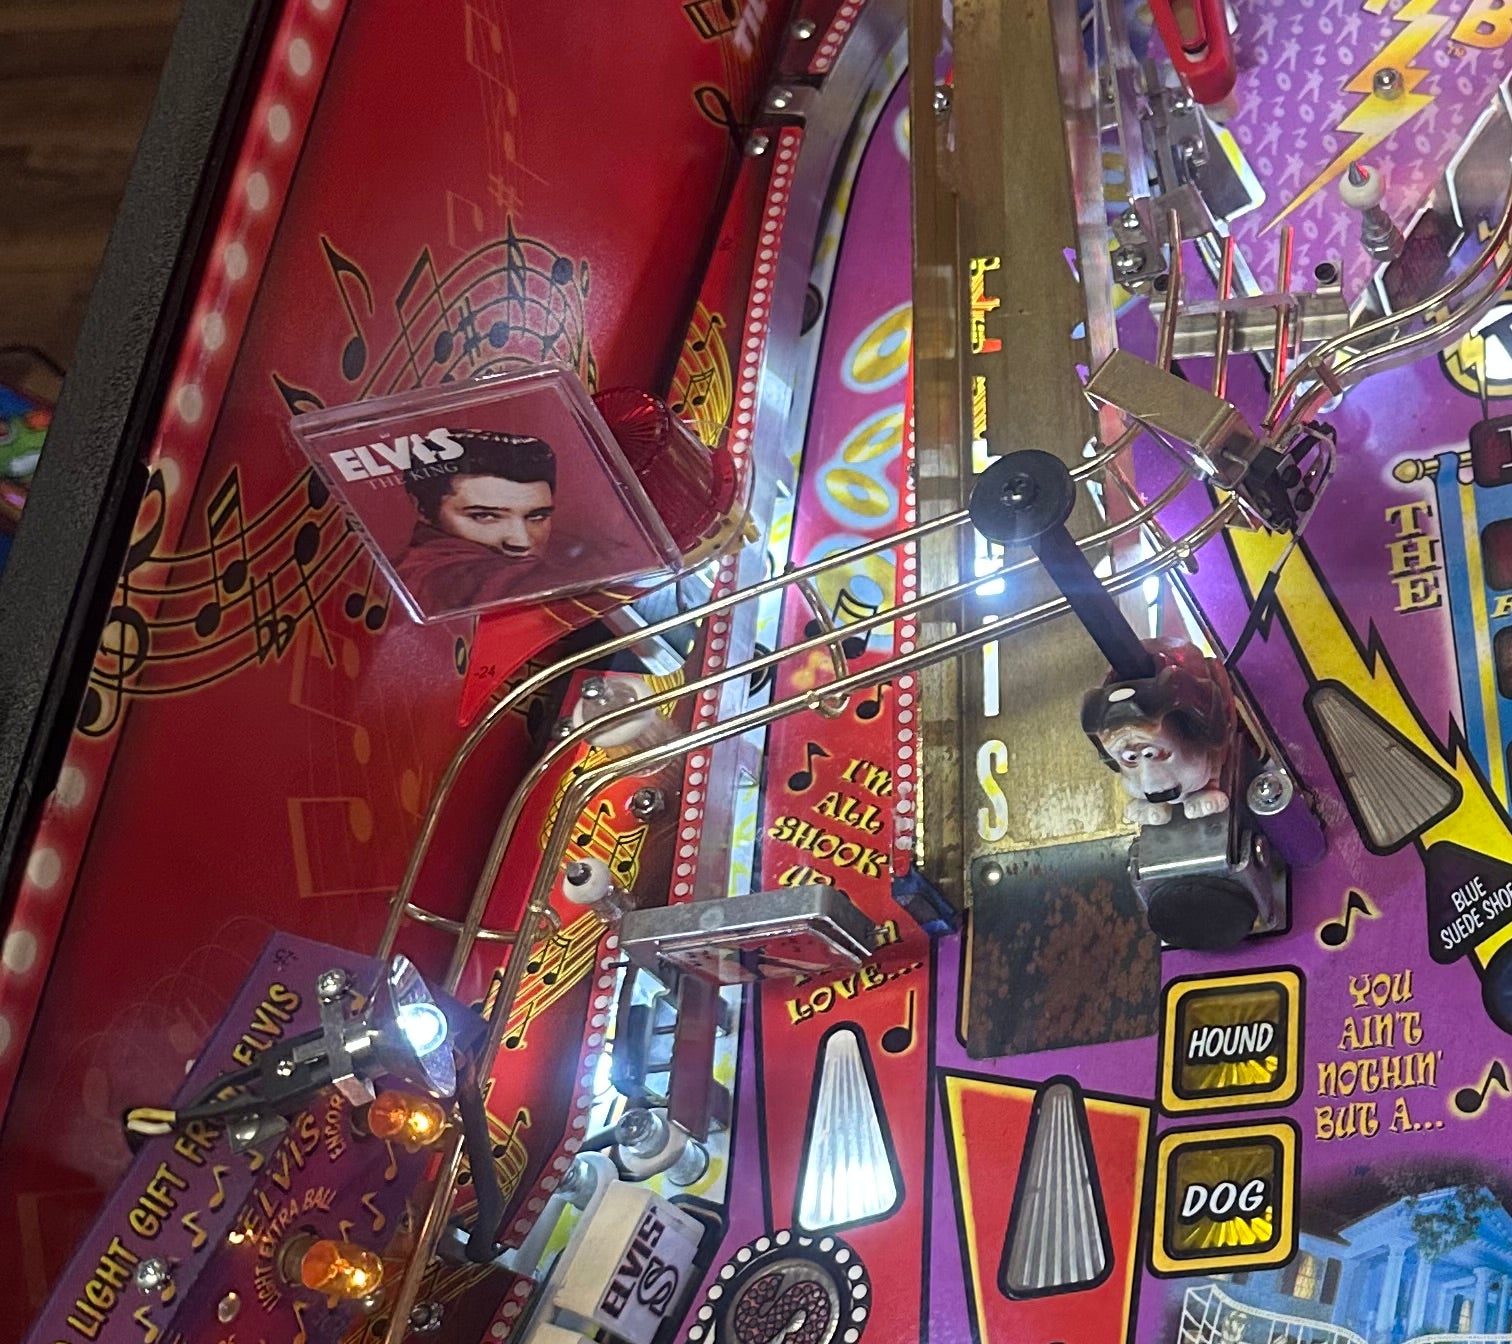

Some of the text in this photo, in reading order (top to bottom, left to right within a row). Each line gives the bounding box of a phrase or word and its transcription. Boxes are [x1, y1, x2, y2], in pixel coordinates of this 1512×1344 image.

[329, 428, 465, 482] ELVIS
[367, 461, 459, 491] THE KING
[1386, 502, 1442, 613] THE
[812, 791, 885, 836] ALL
[768, 815, 891, 879] SHOOK
[1450, 875, 1489, 914] BLUE
[1440, 905, 1485, 950] SUEDE
[785, 961, 924, 1025] LOVE...
[1349, 969, 1413, 1007] YOU
[232, 982, 302, 1066] ELVIS
[1188, 1022, 1274, 1059] HOUND
[1338, 1010, 1425, 1053] AIN'T
[1317, 1050, 1444, 1098] NOTHIN'
[323, 1093, 348, 1161] ENCOR
[1315, 1101, 1445, 1142] BUT A...
[240, 1112, 323, 1236] ELVIS
[1182, 1180, 1265, 1218] DOG
[258, 1199, 298, 1258] EXTRA
[303, 1186, 337, 1212] BALL
[67, 1236, 139, 1338] LIGHT
[129, 1162, 188, 1238] GIFT
[600, 1206, 666, 1318] ELVIS
[636, 1256, 679, 1317] S
